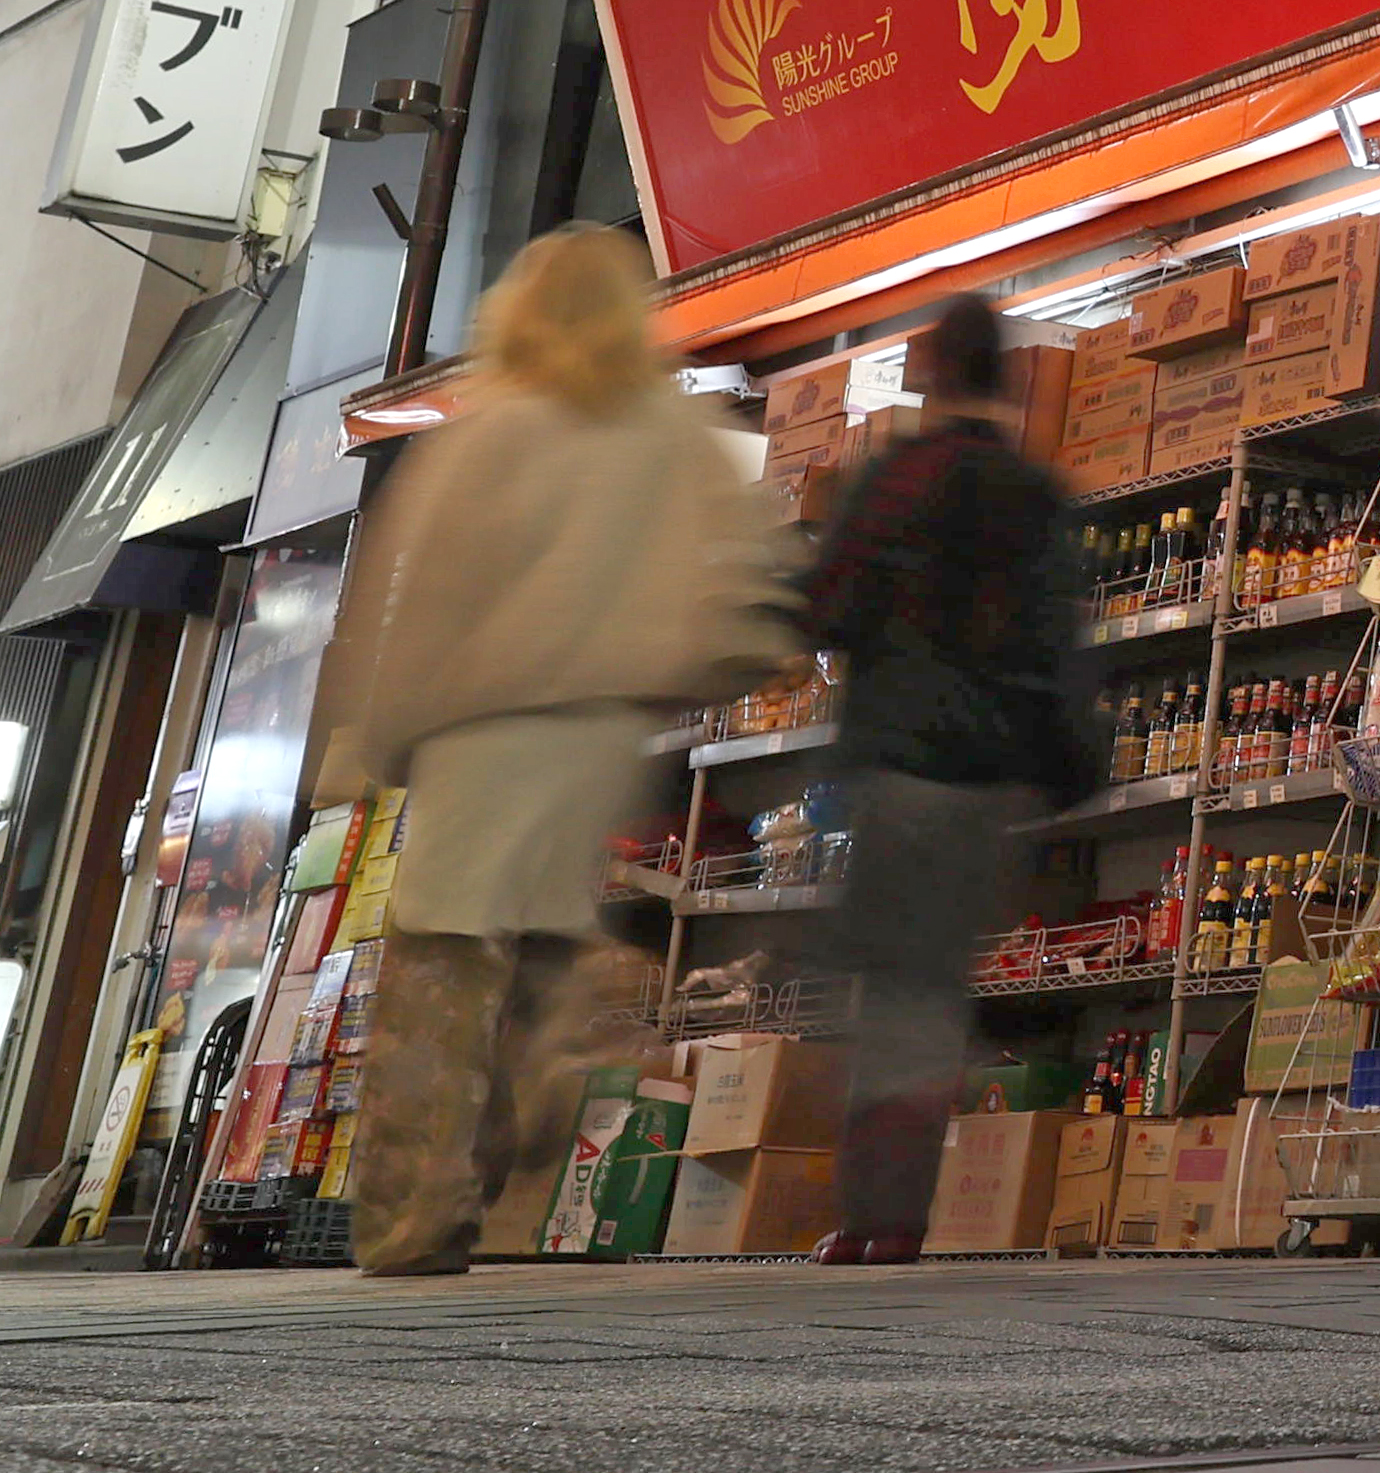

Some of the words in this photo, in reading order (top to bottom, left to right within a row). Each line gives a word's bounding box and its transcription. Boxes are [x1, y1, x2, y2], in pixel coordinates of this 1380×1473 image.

[771, 5, 893, 92] 陽光グループ
[781, 72, 850, 117] SUNSHINE
[849, 51, 899, 89] GROUP
